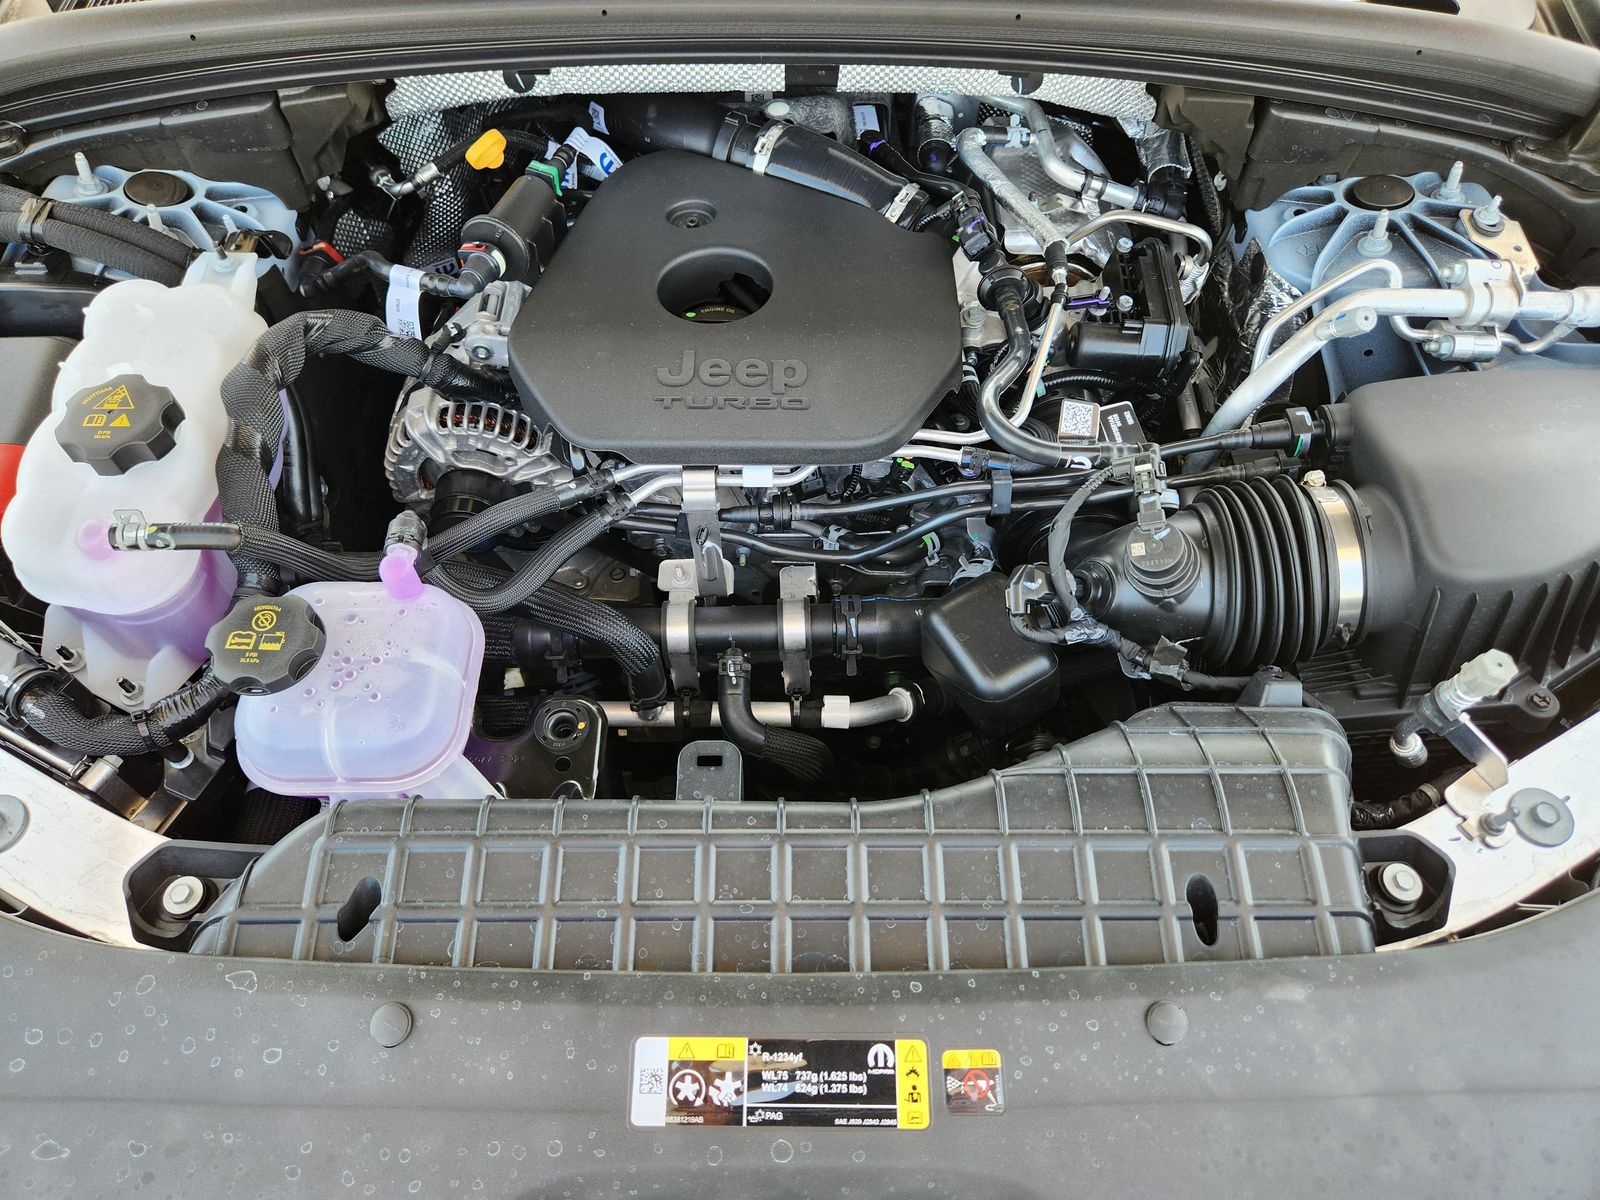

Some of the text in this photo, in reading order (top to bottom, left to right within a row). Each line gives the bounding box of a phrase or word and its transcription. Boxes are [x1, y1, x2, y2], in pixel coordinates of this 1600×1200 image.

[656, 350, 808, 395] Jeep
[654, 396, 811, 410] TURBO
[762, 1051, 804, 1064] R-1234yf
[761, 1070, 868, 1084] WL75 737g (1.625 lbs)
[761, 1083, 868, 1096] WL74 624g (1.375 lbs)
[765, 1111, 784, 1121] PAG
